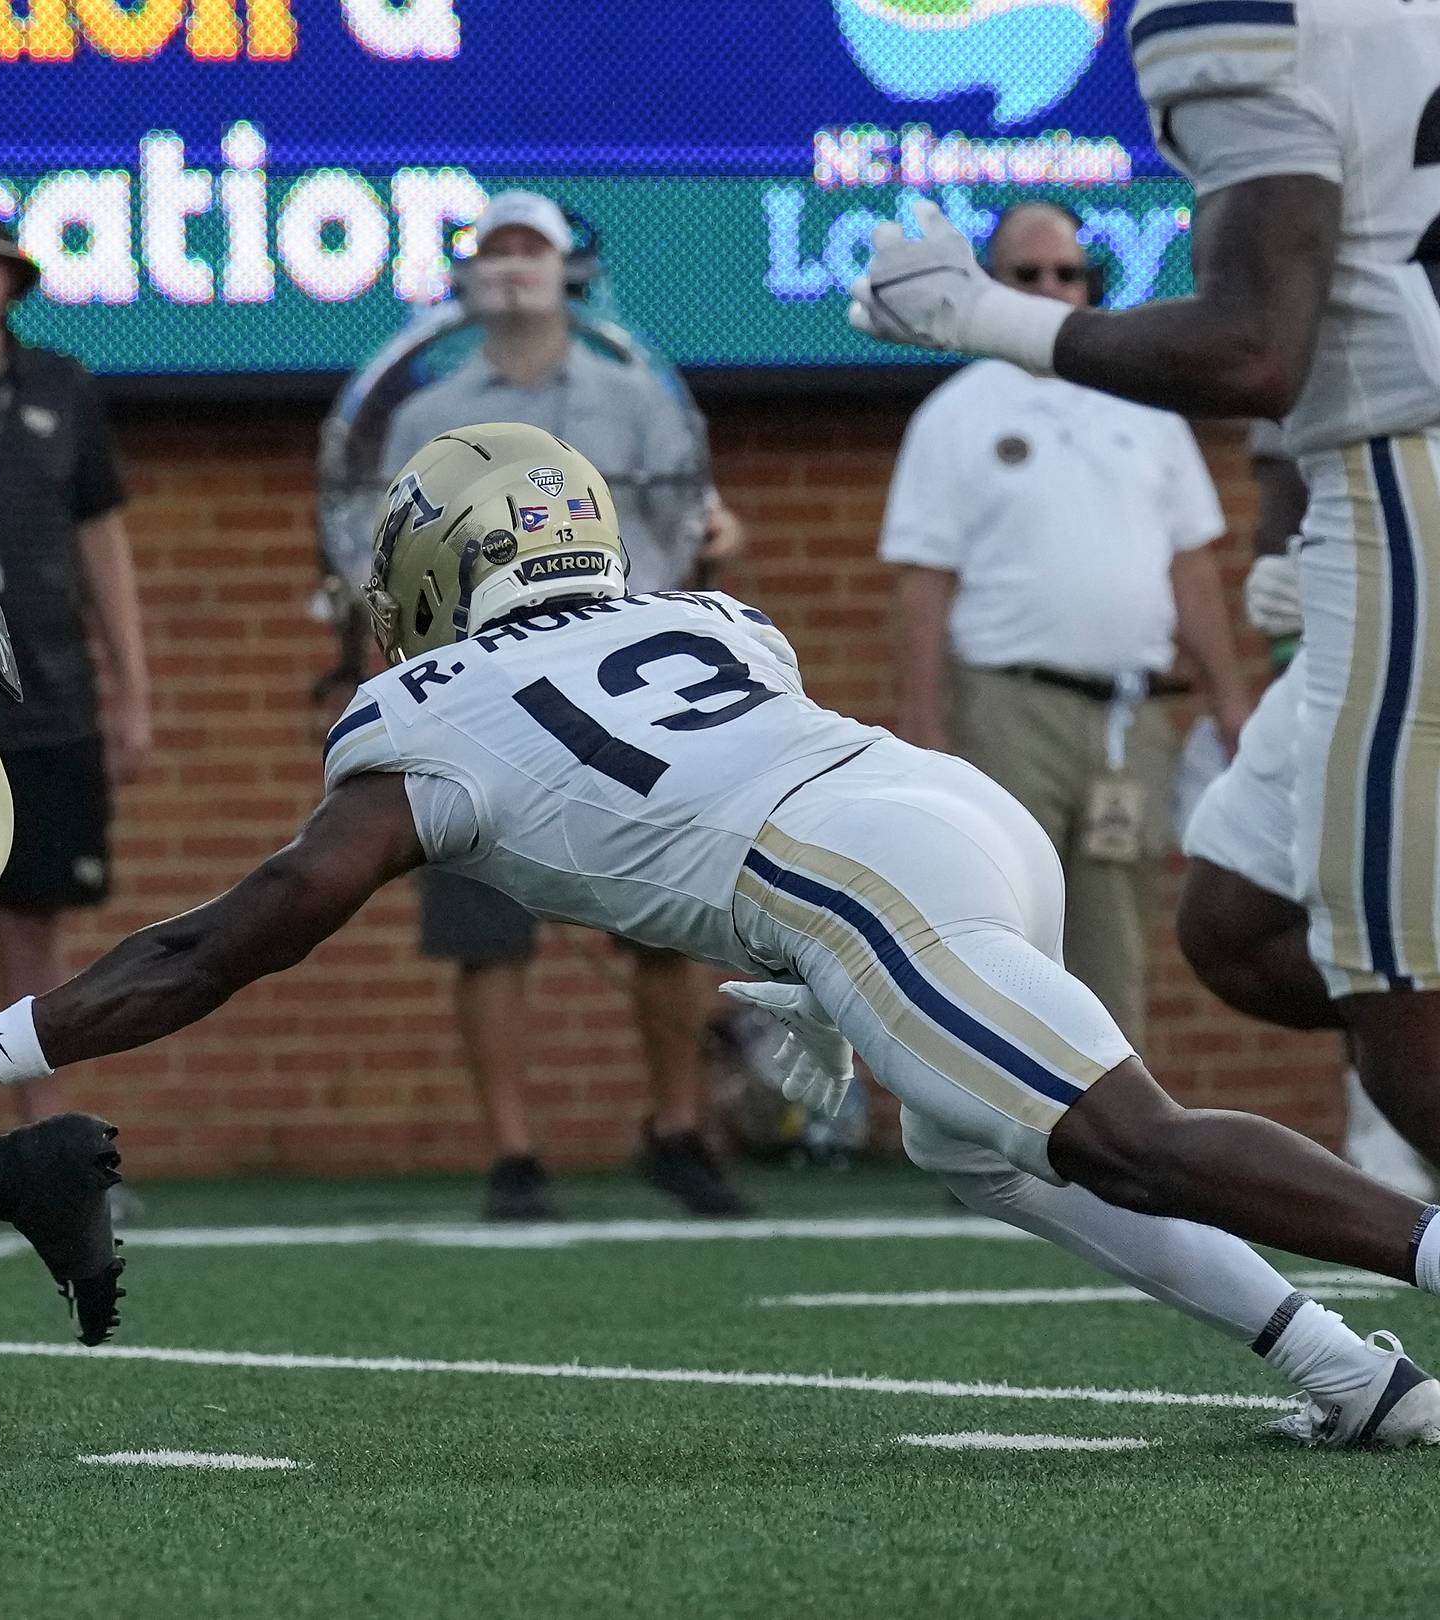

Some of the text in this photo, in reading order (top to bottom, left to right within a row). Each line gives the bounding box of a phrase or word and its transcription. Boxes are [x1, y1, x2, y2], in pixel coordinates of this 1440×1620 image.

[555, 528, 575, 543] 13
[530, 555, 604, 578] AKRON
[399, 660, 465, 704] R.
[512, 631, 788, 798] 13
